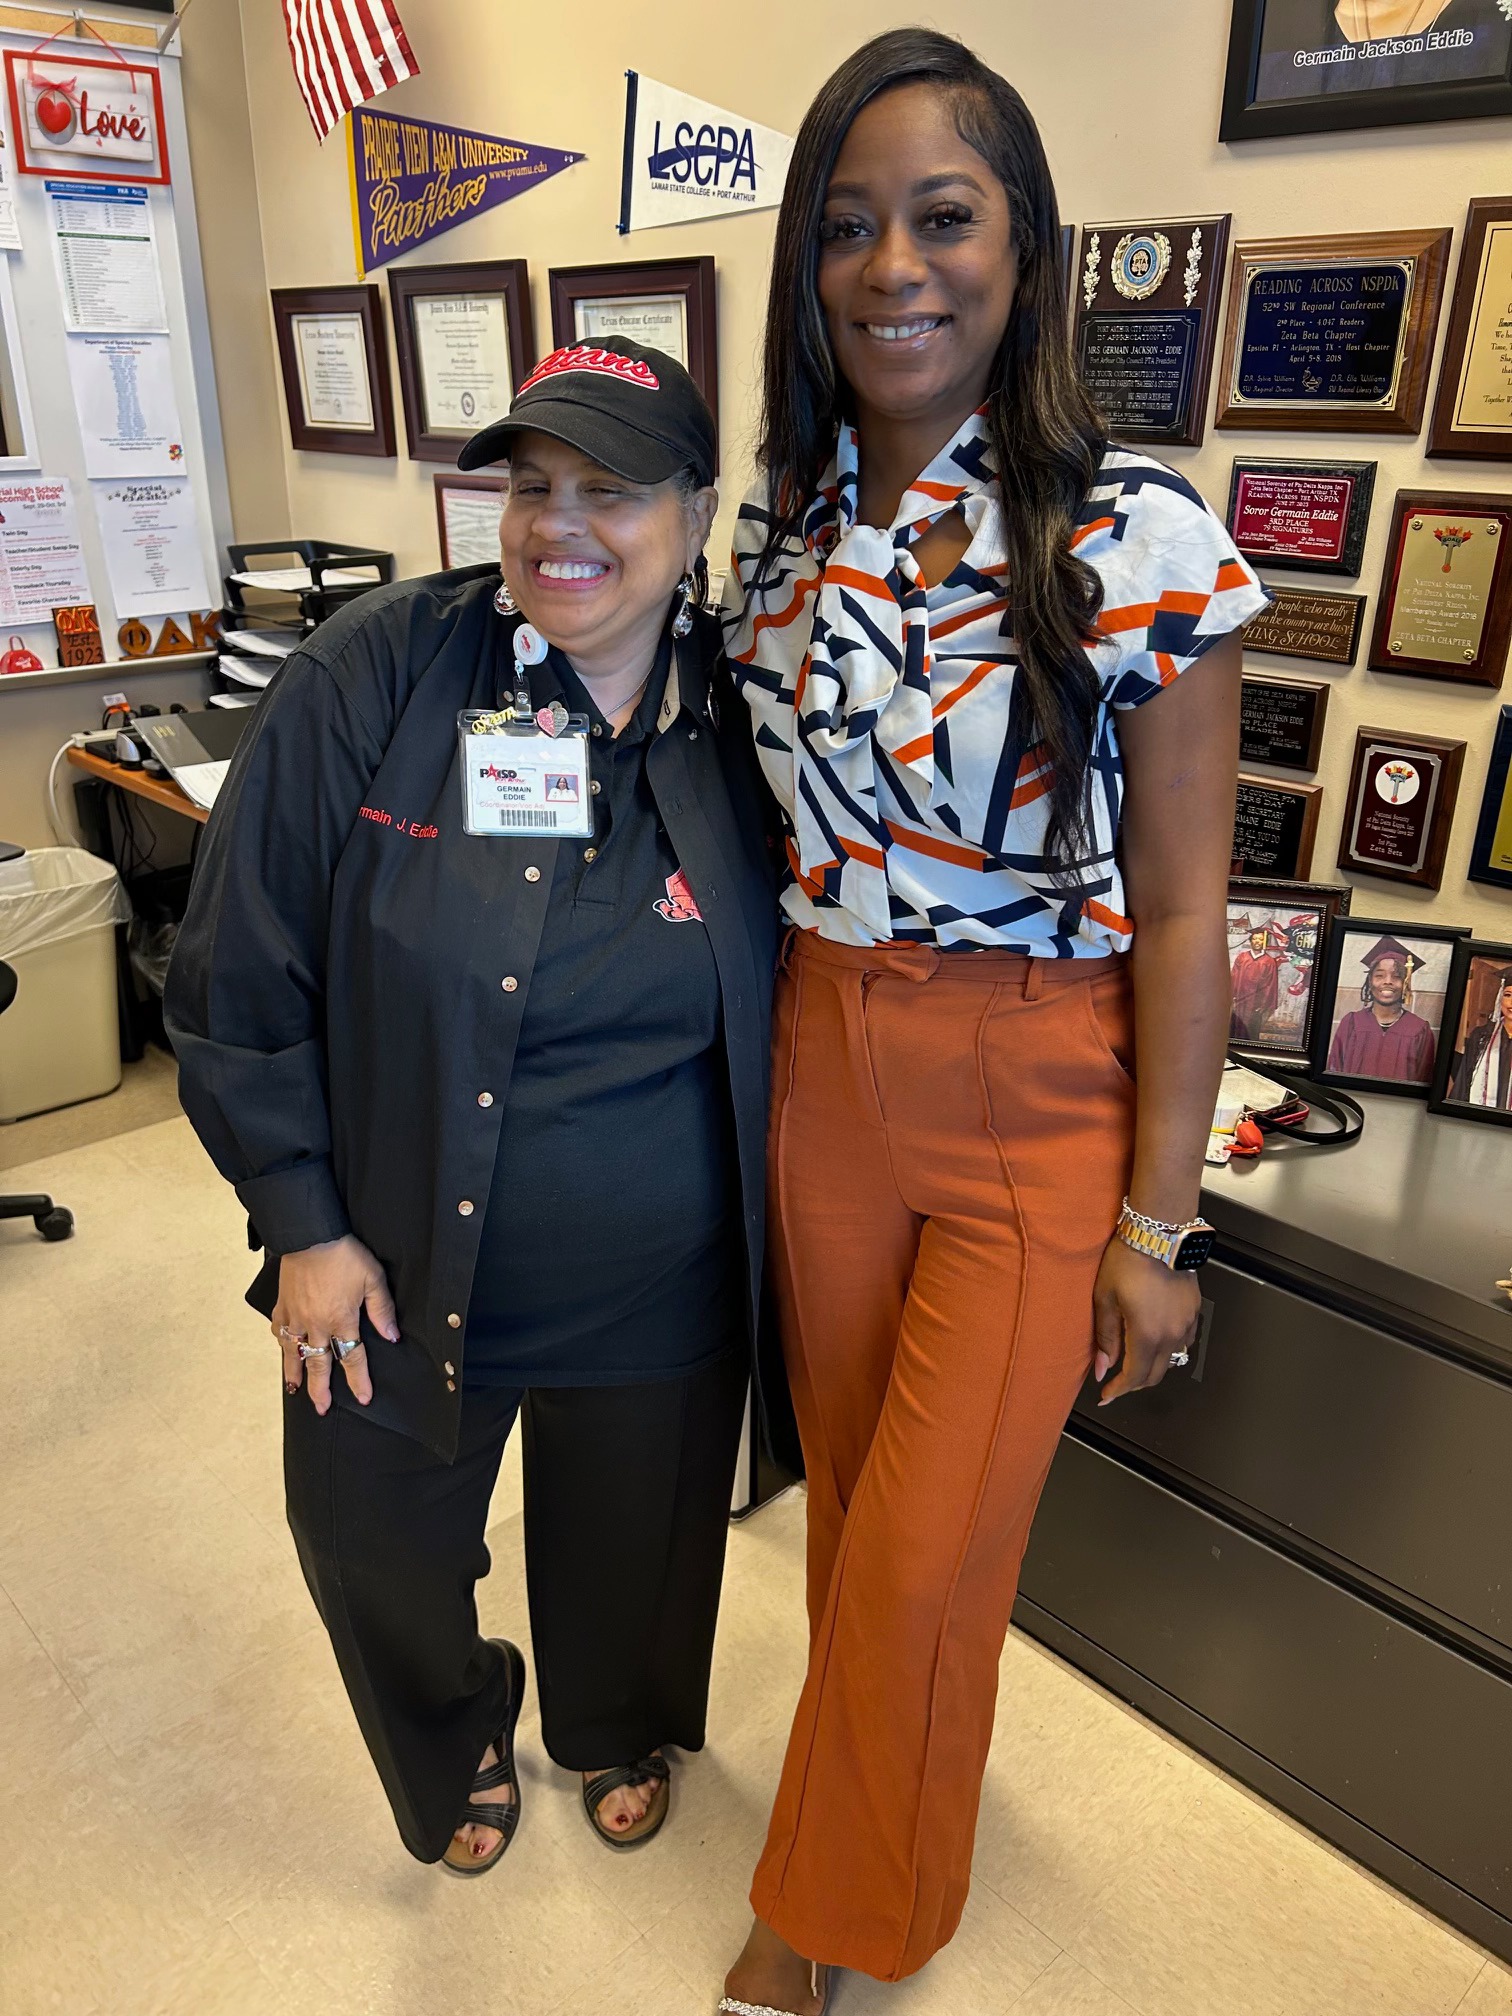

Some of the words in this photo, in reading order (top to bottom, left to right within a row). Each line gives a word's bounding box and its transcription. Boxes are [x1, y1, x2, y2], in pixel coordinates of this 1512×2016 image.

[1293, 45, 1355, 68] Germain
[1358, 37, 1423, 59] Jackson
[1426, 29, 1473, 50] Eddie
[80, 90, 147, 142] Love
[361, 114, 402, 182] PRAIRIE
[400, 123, 429, 176] VIEW
[432, 129, 458, 173] A&M
[458, 135, 529, 169] UNIVERSITY
[649, 120, 756, 191] LSCPA
[488, 161, 548, 181] www.pvamu.edu
[651, 182, 668, 192] LAMAR
[669, 184, 685, 194] STATE
[686, 186, 711, 197] COLLEGE
[716, 189, 732, 199] PORT
[732, 191, 756, 203] ARTHUR
[369, 169, 487, 257] Panthers
[1254, 278, 1302, 295] READING
[1309, 277, 1354, 293] ACROSS
[1360, 275, 1401, 292] NSPDK
[1283, 301, 1297, 312] SW
[1301, 300, 1335, 313] Regional
[1340, 300, 1386, 311] Conference
[600, 316, 618, 326] Texas
[643, 314, 673, 324] Certificate
[1289, 319, 1305, 327] Place
[1339, 318, 1365, 326] Readers
[1280, 331, 1297, 341] Zeta
[1302, 331, 1319, 340] Beta
[1324, 329, 1357, 341] Chapter
[1102, 346, 1129, 355] GERMAIN
[1130, 345, 1159, 355] JACKSON
[1165, 345, 1183, 355] EDDIE
[1247, 344, 1269, 352] Epsilon
[1345, 343, 1361, 351] Host
[1364, 343, 1391, 352] Chapter
[1490, 342, 1508, 351] Time,
[1288, 355, 1305, 363] April
[13, 487, 34, 495] High
[35, 484, 64, 493] School
[36, 493, 61, 501] Week
[1243, 505, 1269, 516] Soror
[1270, 506, 1310, 519] Germain
[1311, 509, 1339, 521] Eddie
[1269, 517, 1284, 525] 3RD
[1285, 518, 1309, 527] PLACE
[1271, 525, 1314, 534] SIGNATURES
[1274, 600, 1302, 615] people
[1303, 602, 1321, 614] who
[1323, 604, 1349, 621] really
[1400, 606, 1437, 617] Membership
[1438, 609, 1460, 618] Award
[1269, 613, 1282, 626] the
[1282, 618, 1312, 632] country
[1314, 622, 1328, 631] are
[1329, 621, 1351, 637] busy
[67, 634, 95, 648] Est.
[1279, 629, 1341, 650] SCHOOL
[1395, 631, 1415, 641] ZETA
[1416, 633, 1435, 643] BETA
[1437, 636, 1472, 647] CHAPTER
[66, 646, 103, 667] 1923
[1243, 709, 1264, 719] GERMAIN
[1266, 713, 1289, 722] JACKSON
[1289, 716, 1304, 726] EDDIE
[1244, 726, 1284, 736] READERS
[1253, 720, 1278, 729] PLACE
[496, 785, 532, 793] GERMAIN
[1249, 789, 1280, 801] COUNCIL
[1264, 798, 1285, 808] DAY
[1247, 805, 1286, 820] SECRETARY
[409, 822, 439, 839] Eddie
[1263, 819, 1282, 831] EDDIE
[1258, 831, 1271, 842] YOU
[1369, 844, 1385, 854] Zeta
[1387, 847, 1403, 857] Beta
